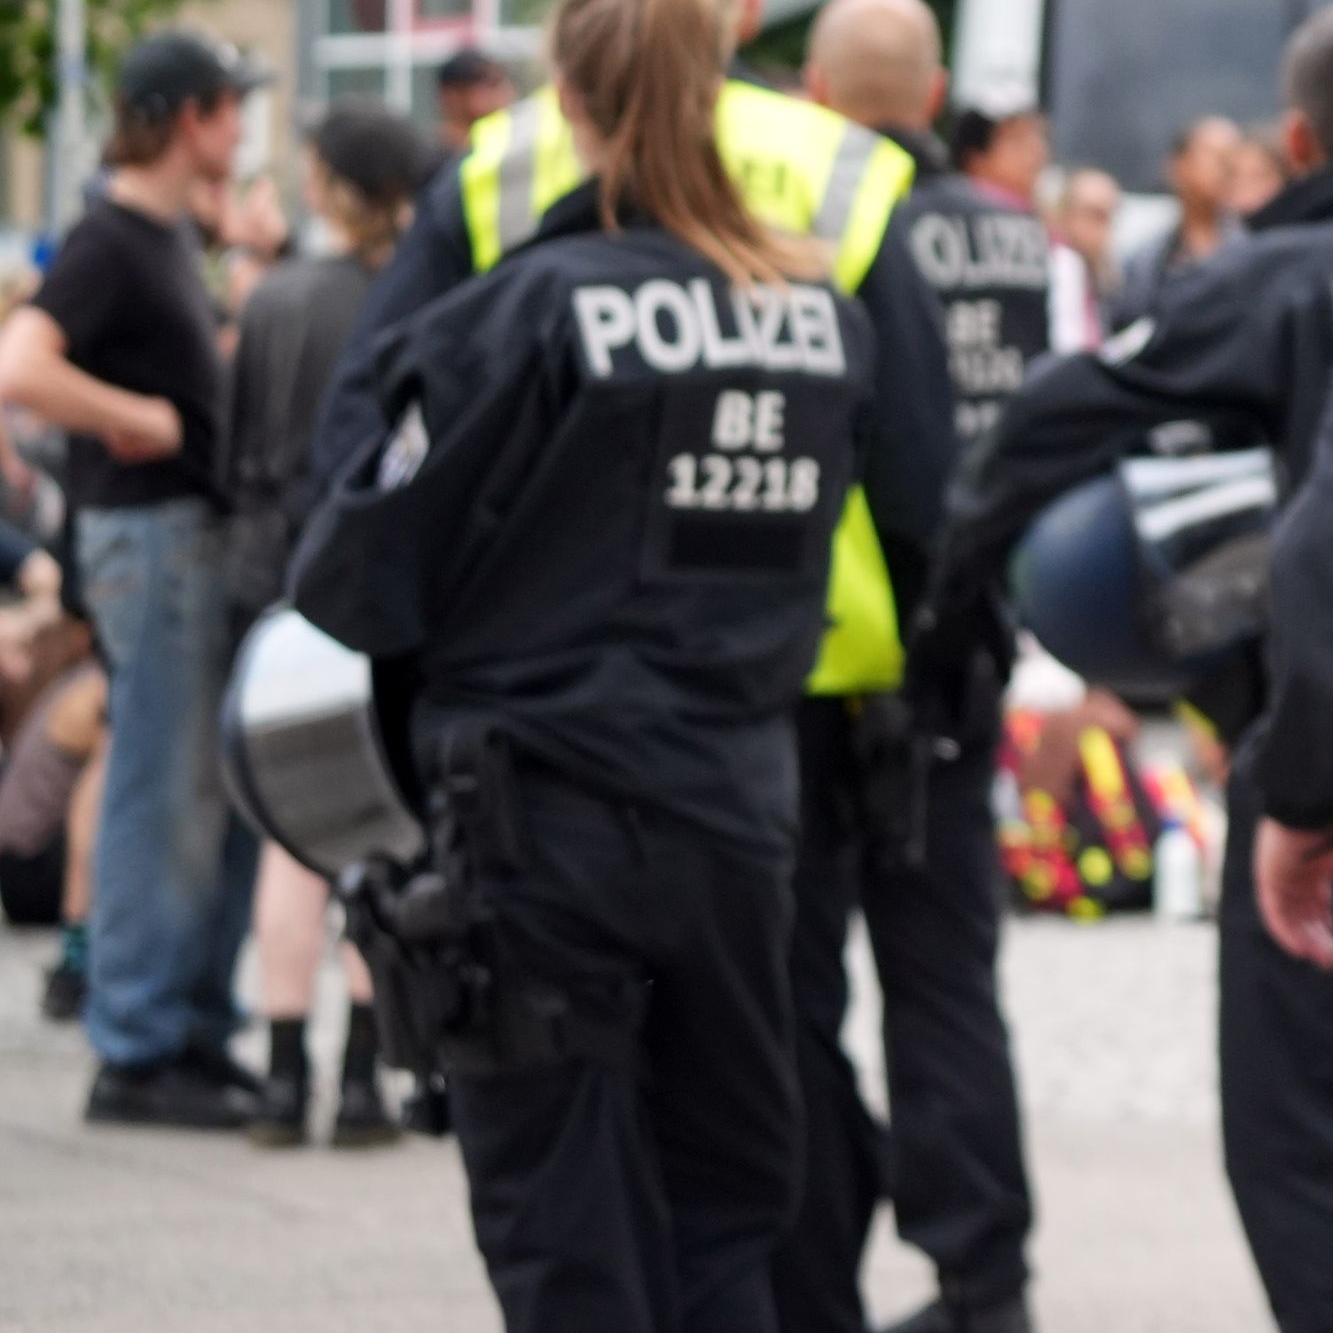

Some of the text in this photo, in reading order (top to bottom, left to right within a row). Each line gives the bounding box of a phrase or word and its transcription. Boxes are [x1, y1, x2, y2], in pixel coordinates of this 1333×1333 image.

[571, 277, 848, 378] POLIZEI
[711, 388, 786, 453] BE
[664, 452, 822, 513] 12218
